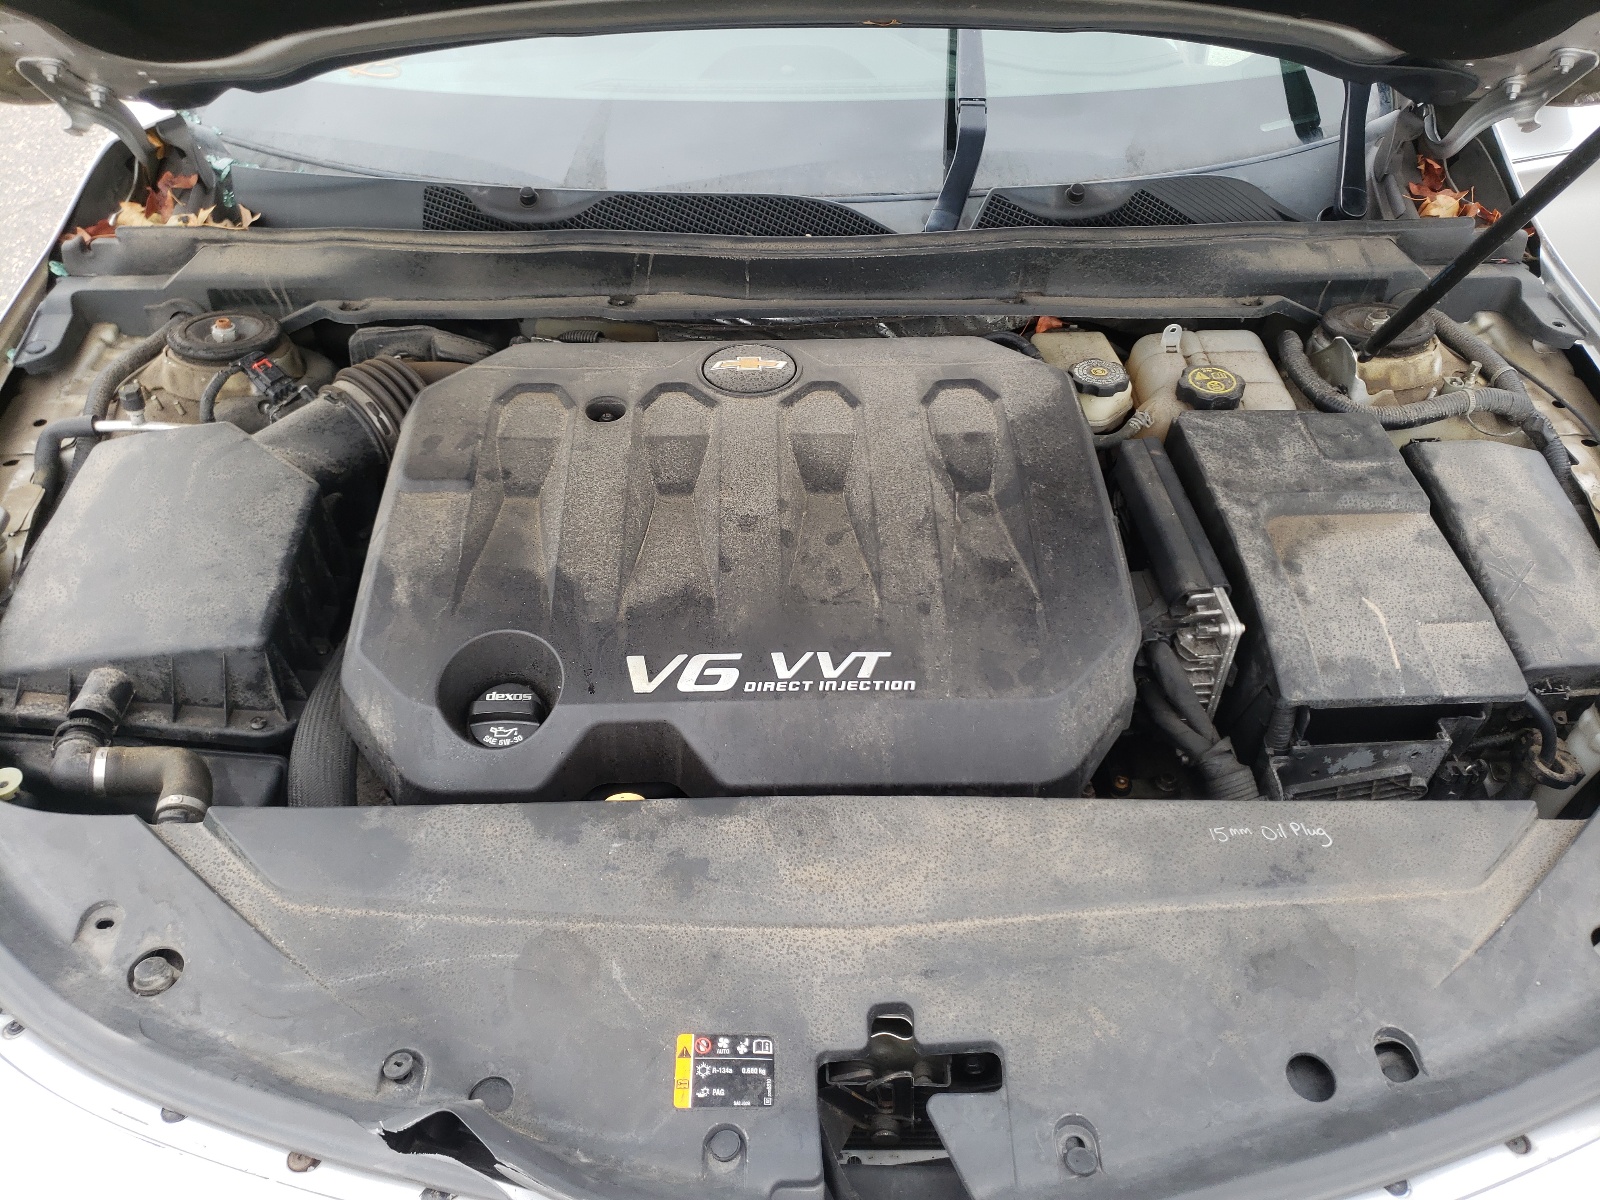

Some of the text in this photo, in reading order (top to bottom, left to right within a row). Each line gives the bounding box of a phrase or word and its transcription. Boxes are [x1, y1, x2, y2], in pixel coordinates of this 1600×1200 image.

[626, 651, 892, 693] V6 VVT
[743, 680, 916, 692] DIRECT INJECTION
[485, 691, 532, 701] dexos
[483, 735, 523, 746] SAE 5W-30
[1260, 823, 1288, 841] Oil
[1289, 822, 1334, 848] Plug
[758, 1067, 767, 1076] kg
[712, 1088, 725, 1096] PAG
